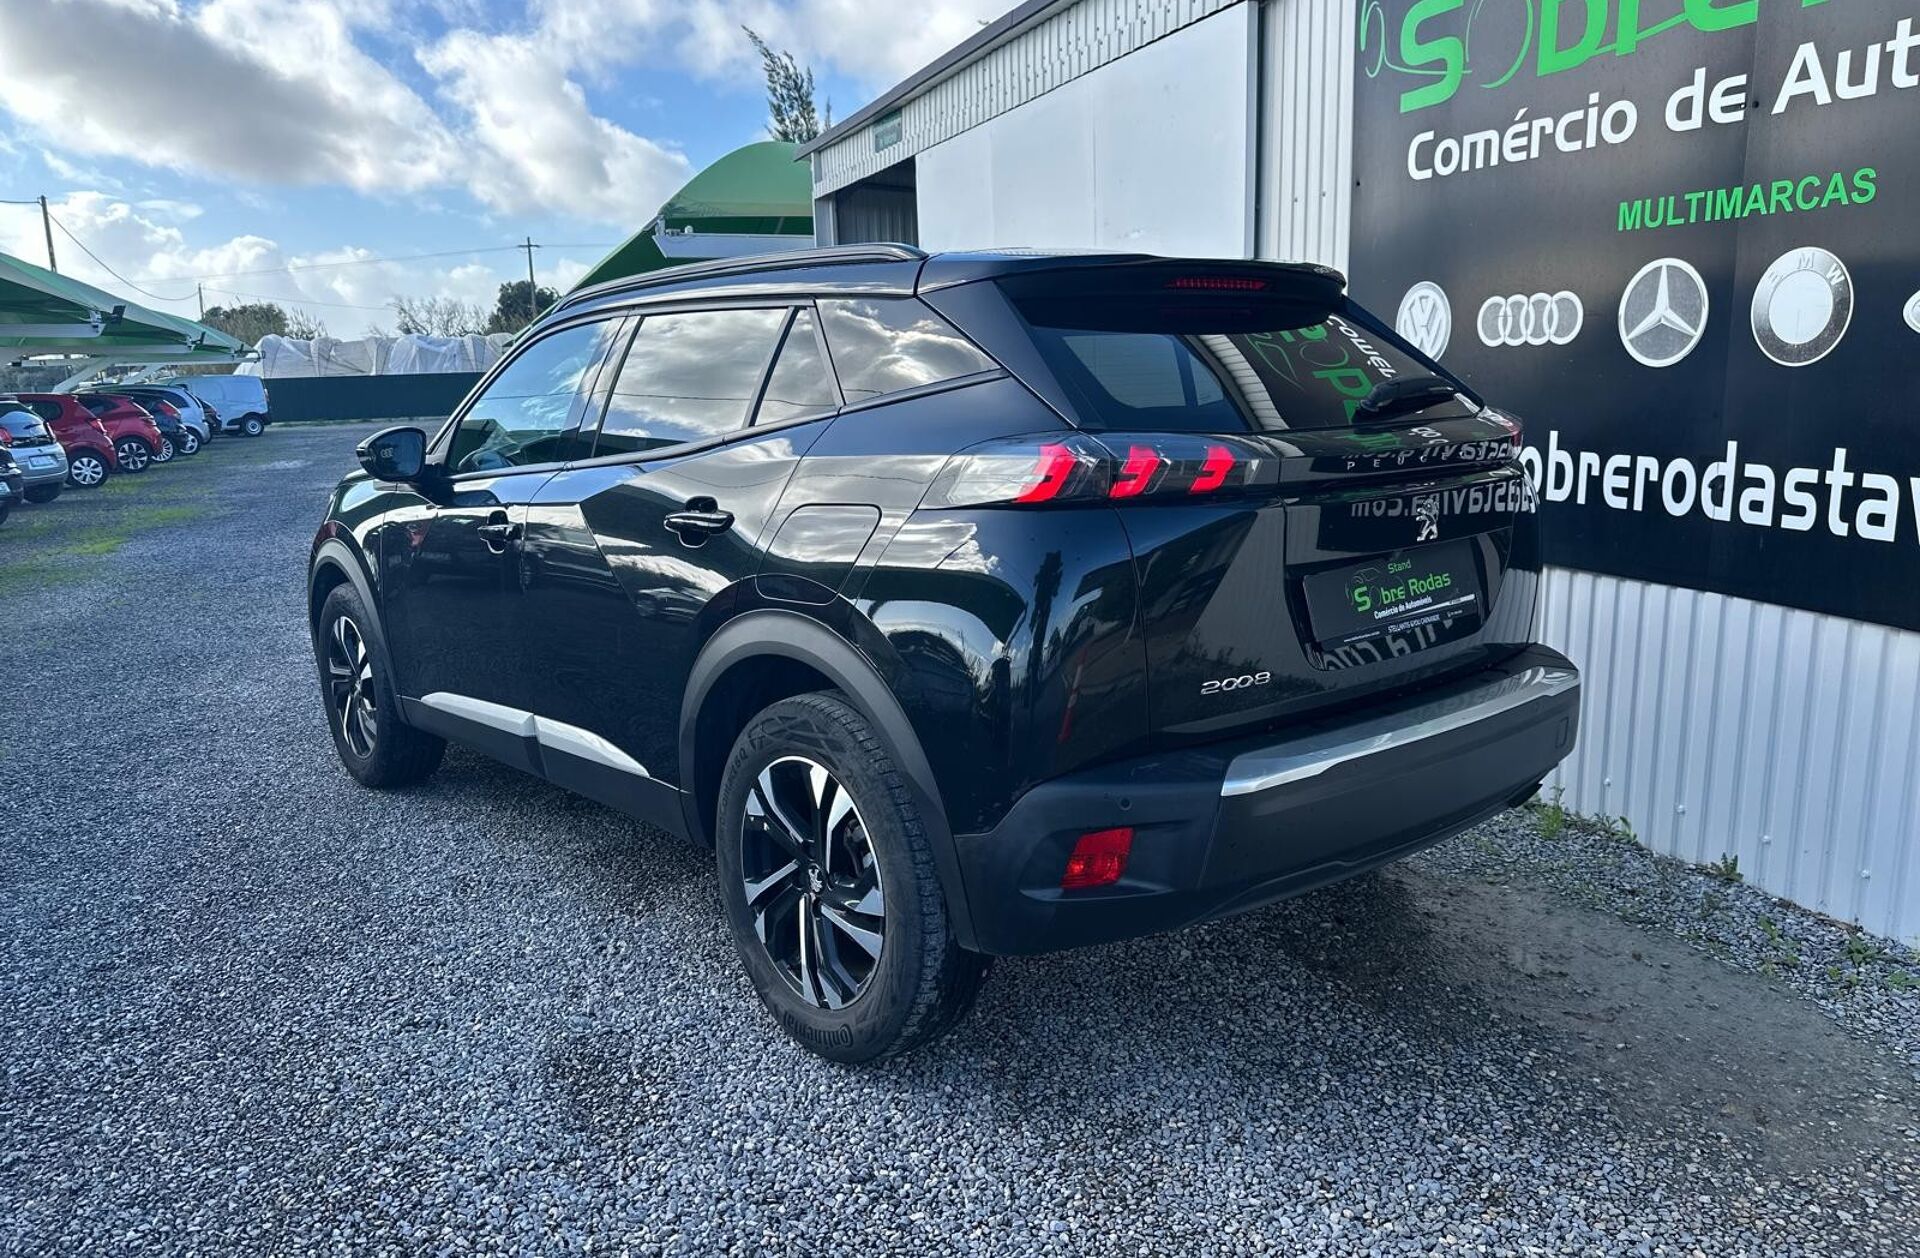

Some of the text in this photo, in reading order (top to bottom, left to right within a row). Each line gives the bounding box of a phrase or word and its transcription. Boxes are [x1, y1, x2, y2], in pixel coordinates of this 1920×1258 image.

[1408, 92, 1638, 180] Comércio
[1665, 67, 1748, 131] de
[1617, 167, 1877, 232] MULTIMARCAS
[1517, 430, 1920, 545] obrerodasta
[1387, 558, 1412, 574] Stand
[1408, 573, 1452, 596] Rodas
[1200, 671, 1271, 695] 2008
